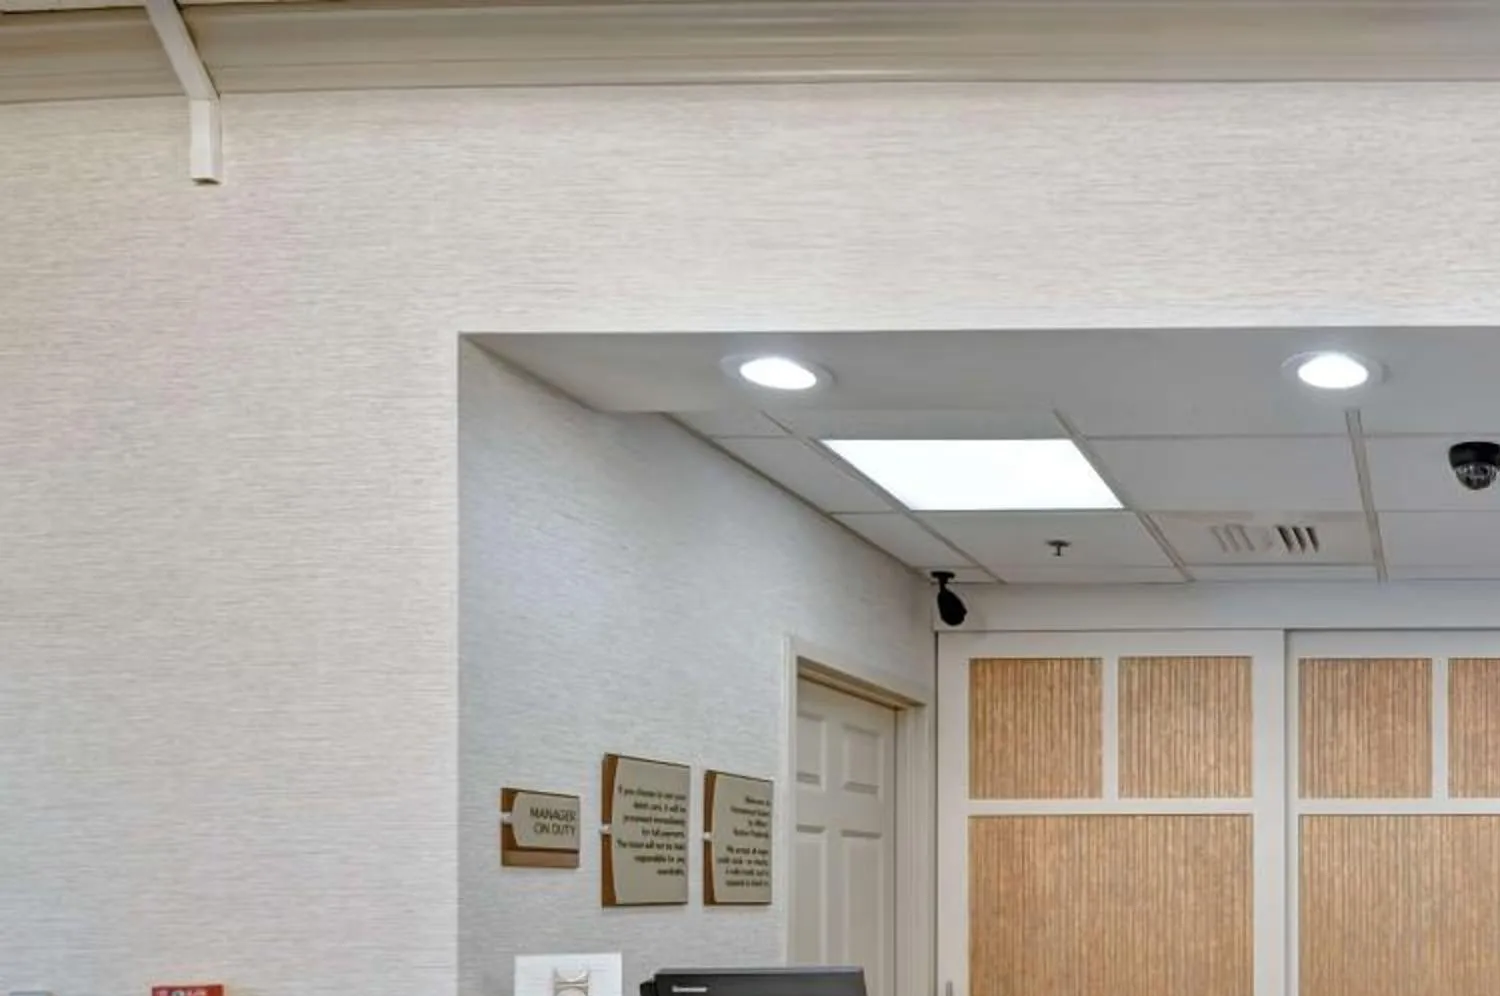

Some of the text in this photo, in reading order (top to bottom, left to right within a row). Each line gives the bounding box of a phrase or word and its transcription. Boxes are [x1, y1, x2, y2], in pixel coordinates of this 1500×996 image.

[530, 806, 577, 822] MANAGER
[534, 821, 577, 838] ON DUTY
